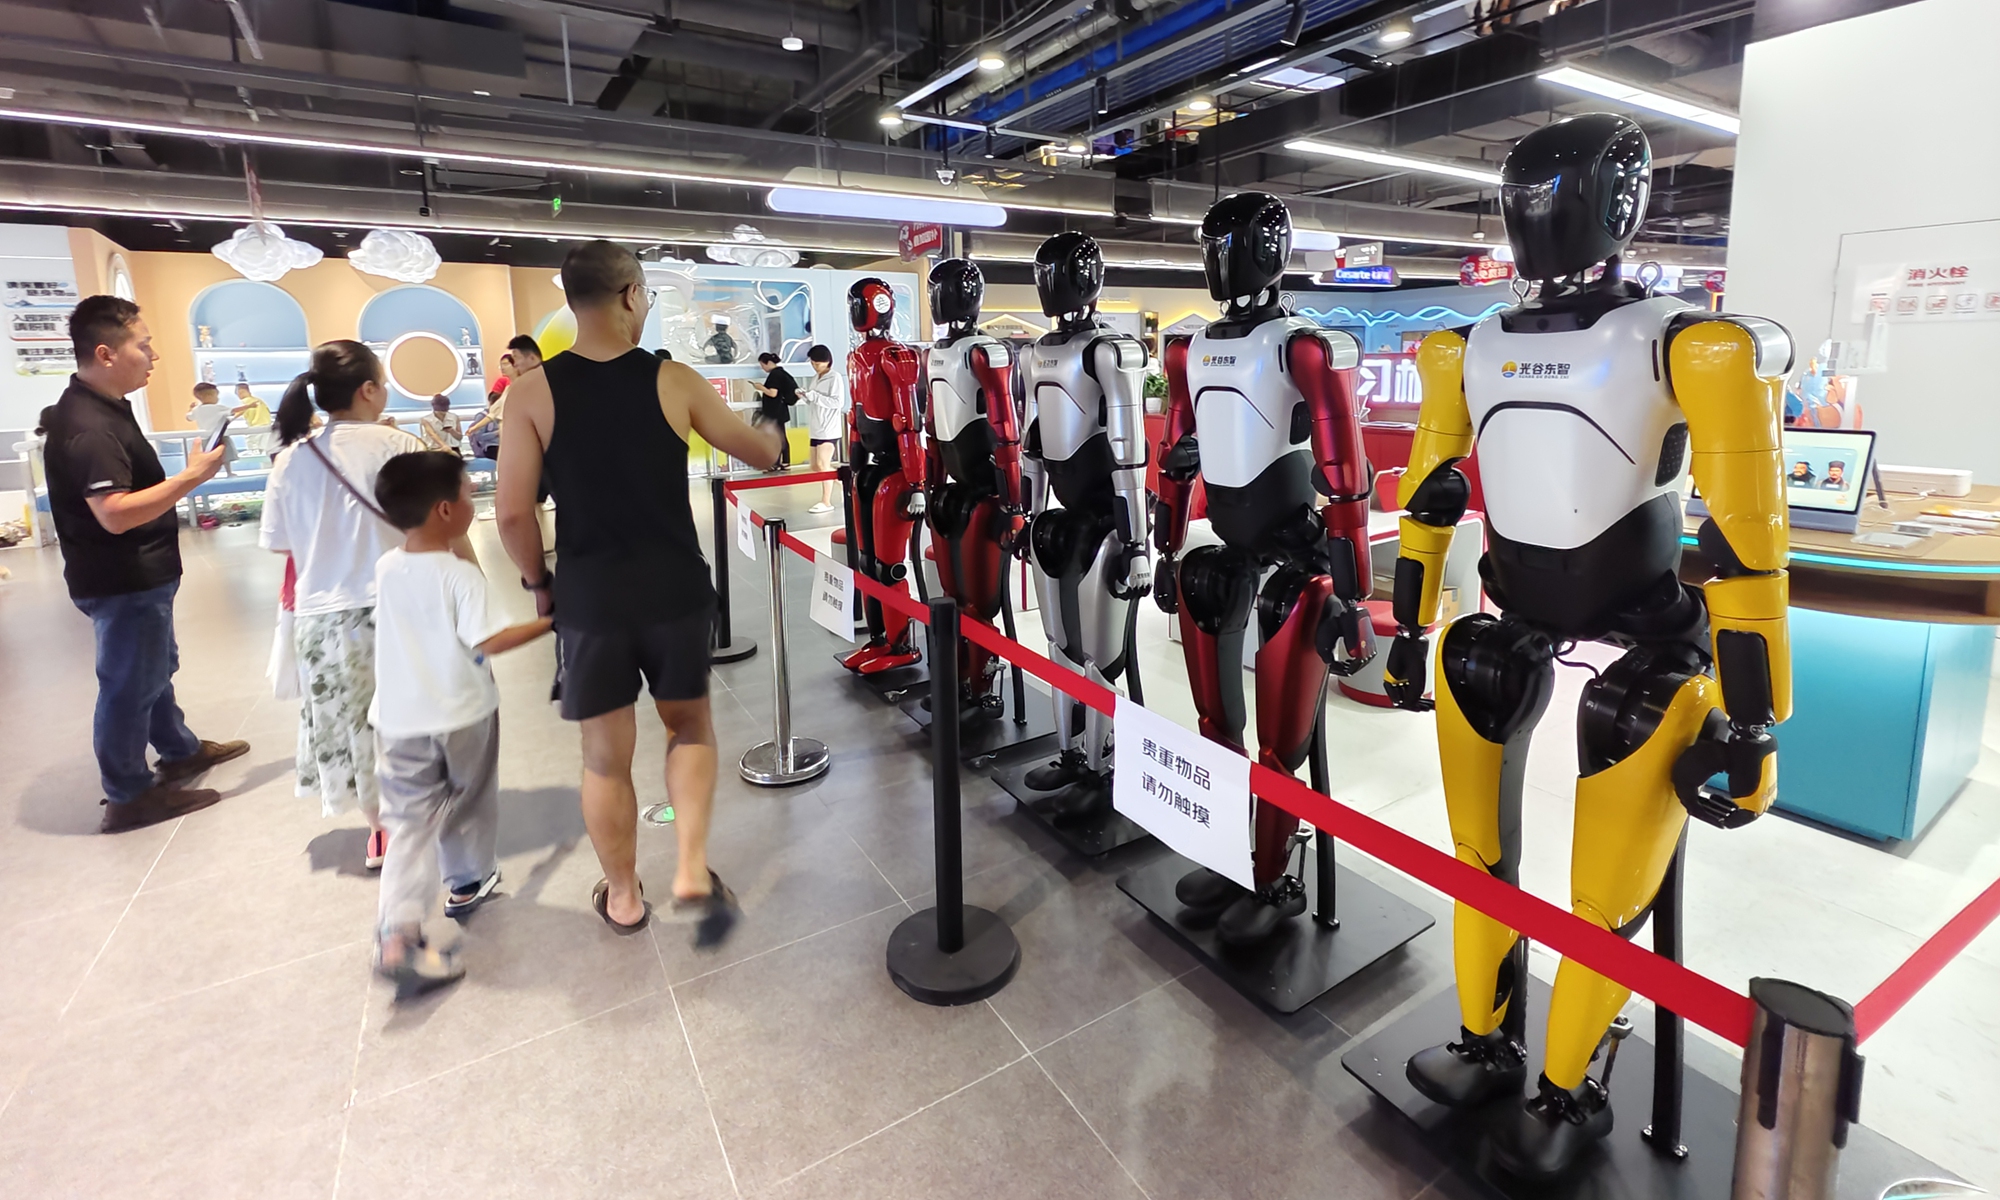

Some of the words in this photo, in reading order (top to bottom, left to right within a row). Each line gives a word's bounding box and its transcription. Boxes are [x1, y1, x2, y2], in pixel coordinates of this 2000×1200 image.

[1908, 266, 1969, 280] 消火栓
[1519, 363, 1571, 375] 光谷东智
[1142, 738, 1211, 791] 贵重物品
[1141, 771, 1211, 829] 请勿触摸
